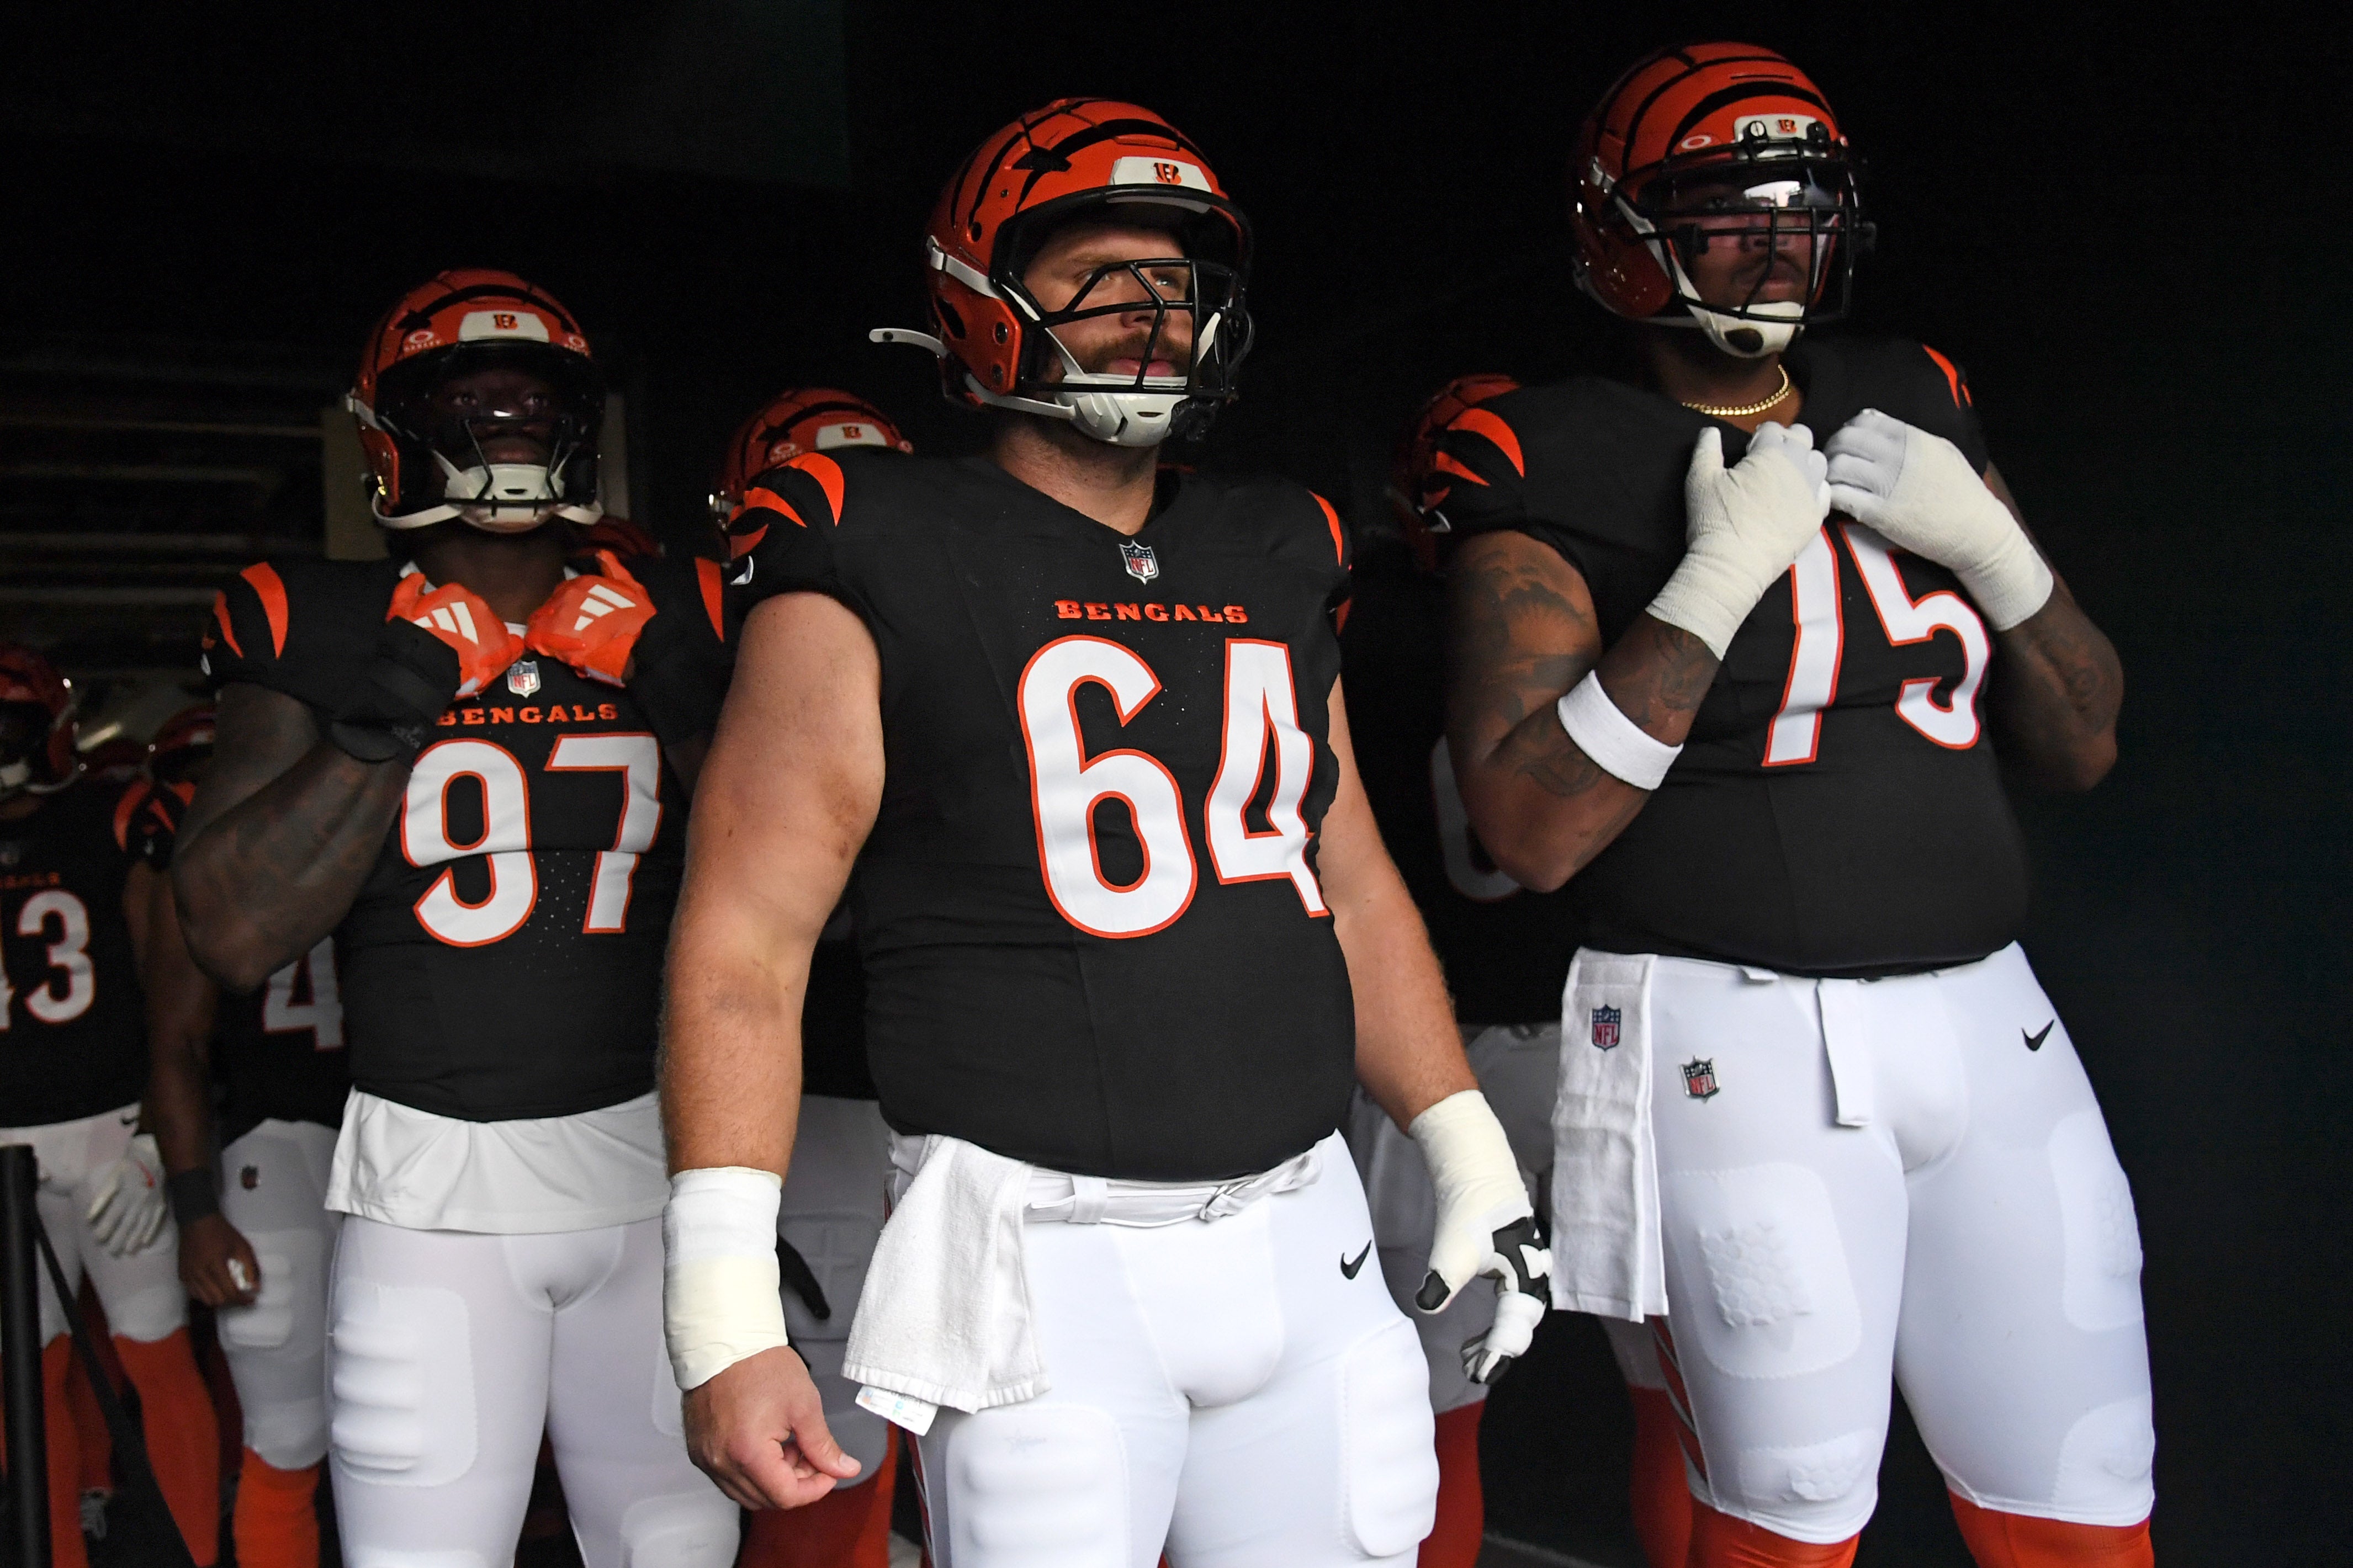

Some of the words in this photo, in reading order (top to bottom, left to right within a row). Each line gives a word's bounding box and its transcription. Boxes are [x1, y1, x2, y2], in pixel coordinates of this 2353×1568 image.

[1130, 557, 1153, 573] NFL
[1054, 599, 1248, 623] BENGALS
[1762, 521, 1990, 767] 75
[513, 674, 536, 688] NFL
[436, 703, 619, 726] BENGALS
[1016, 634, 1329, 938] 64
[400, 731, 663, 948] 97
[0, 887, 97, 1032] 3
[1594, 1023, 1618, 1045] NFL
[1689, 1075, 1715, 1094] NFL
